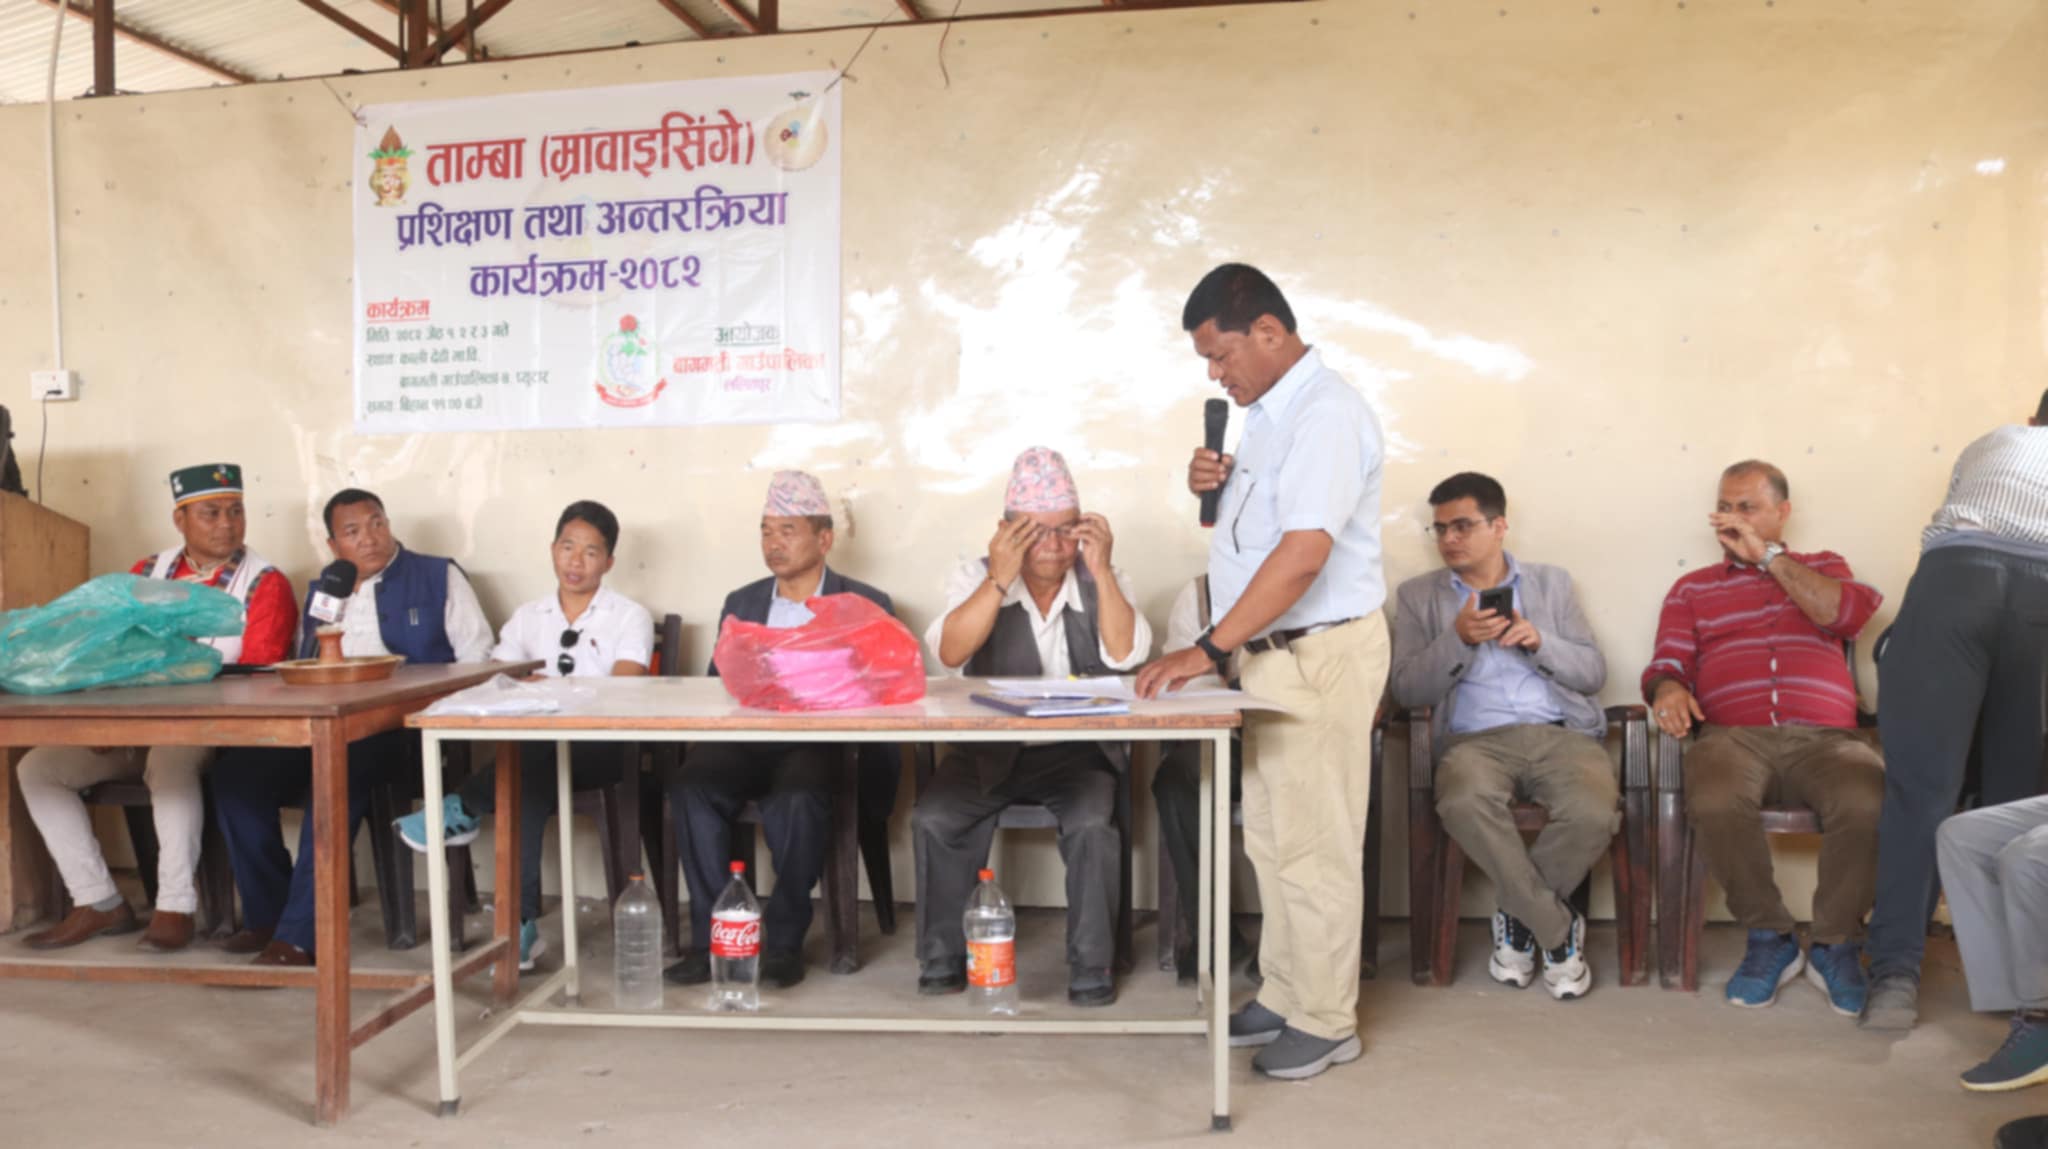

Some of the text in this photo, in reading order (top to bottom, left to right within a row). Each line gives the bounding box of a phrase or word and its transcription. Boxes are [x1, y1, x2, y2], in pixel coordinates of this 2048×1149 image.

[426, 137, 526, 187] ताम्बा
[397, 184, 789, 250] प्रशिक्षण तथा अन्तरक्रिया
[366, 298, 431, 318] कार्यक्रम
